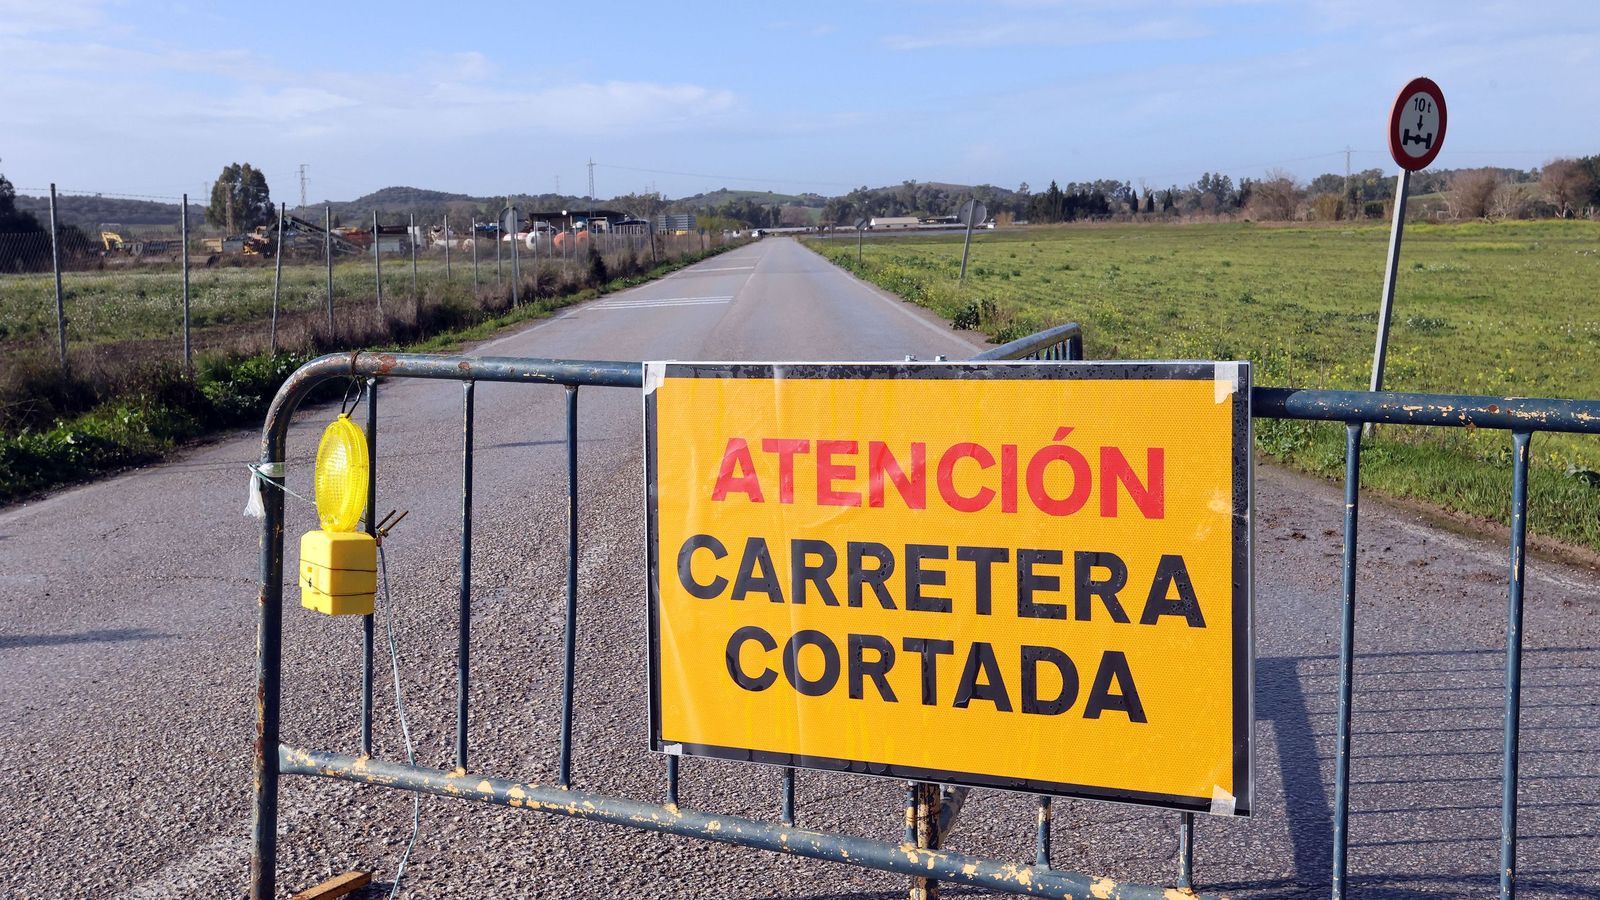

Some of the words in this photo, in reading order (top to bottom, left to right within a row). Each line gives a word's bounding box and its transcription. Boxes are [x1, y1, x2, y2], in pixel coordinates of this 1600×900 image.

[1414, 97, 1426, 112] 10
[1427, 102, 1432, 113] t
[711, 426, 1165, 519] ATENCIÓN
[677, 534, 1207, 629] CARRETERA
[725, 626, 1148, 724] CORTADA
